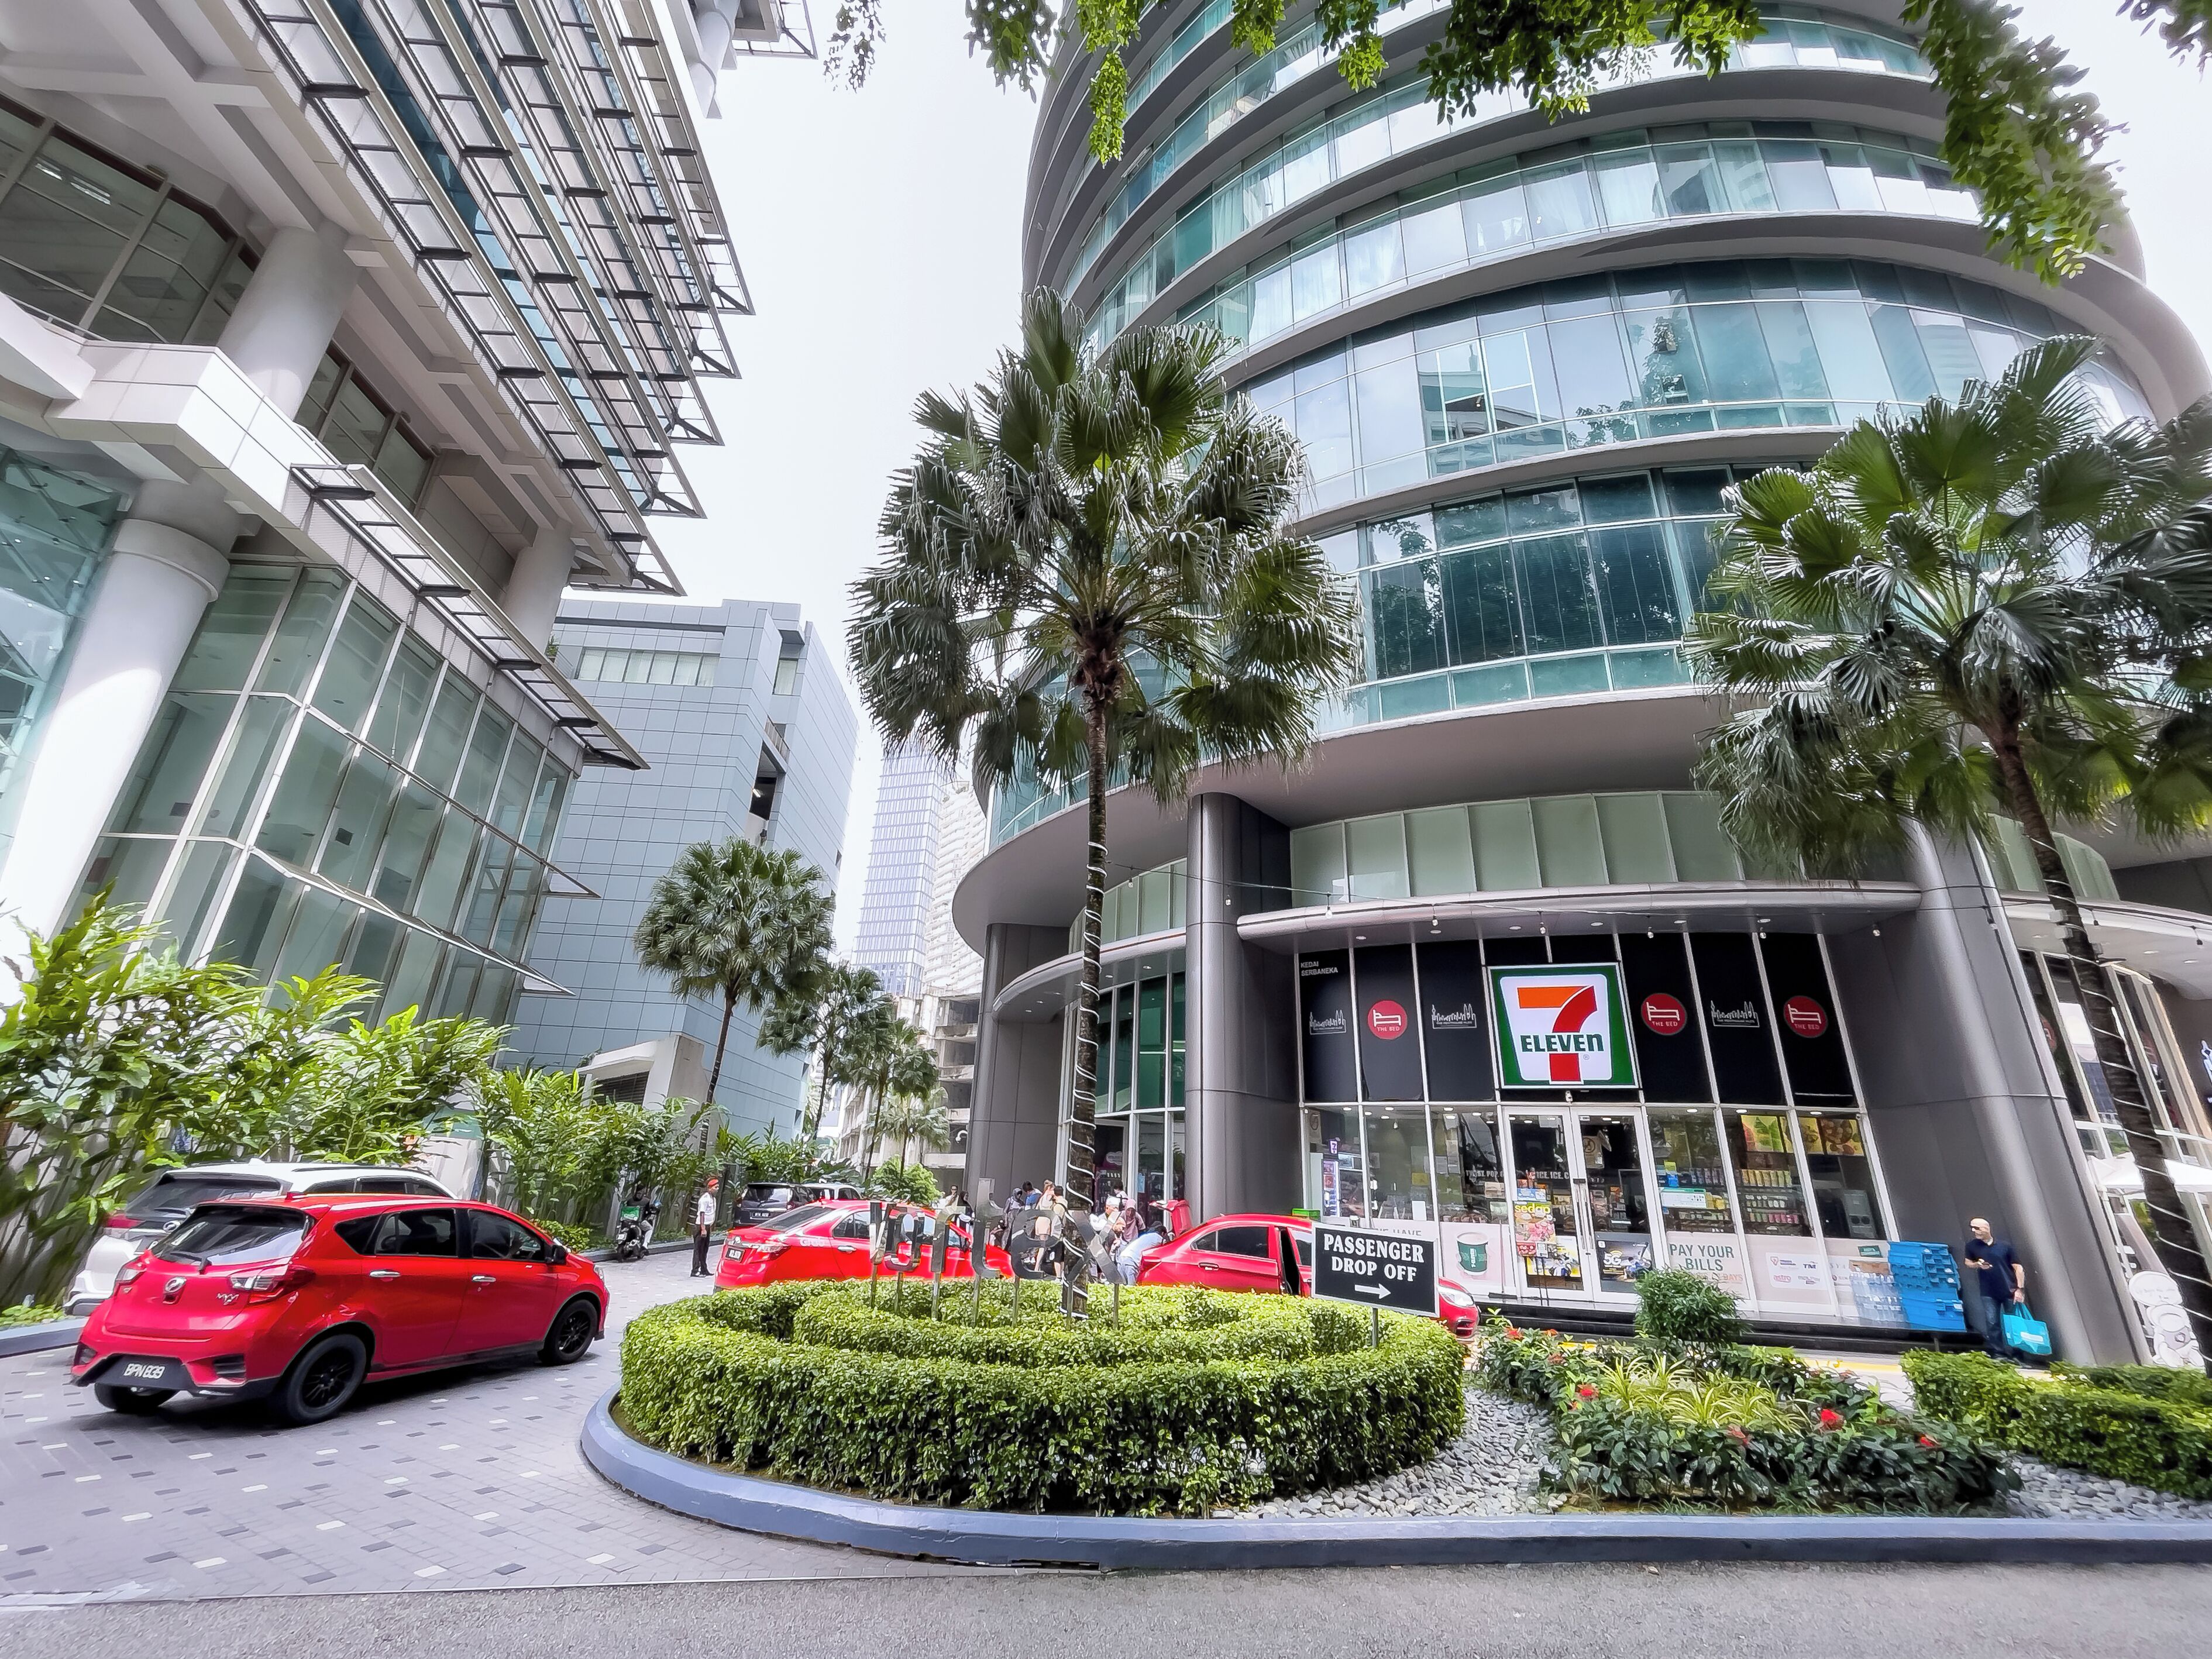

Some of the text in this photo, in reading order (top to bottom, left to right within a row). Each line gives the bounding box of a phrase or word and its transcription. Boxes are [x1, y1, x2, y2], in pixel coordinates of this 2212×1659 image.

[1301, 967, 1339, 976] SERBANEKA
[1517, 985, 1598, 1082] 7
[1323, 1233, 1425, 1263] PASSENGER
[1669, 1244, 1735, 1258] PAY YOUR
[1603, 1252, 1622, 1265] 5G
[1685, 1258, 1723, 1271] BILLS
[1331, 1256, 1417, 1282] DROP OFF
